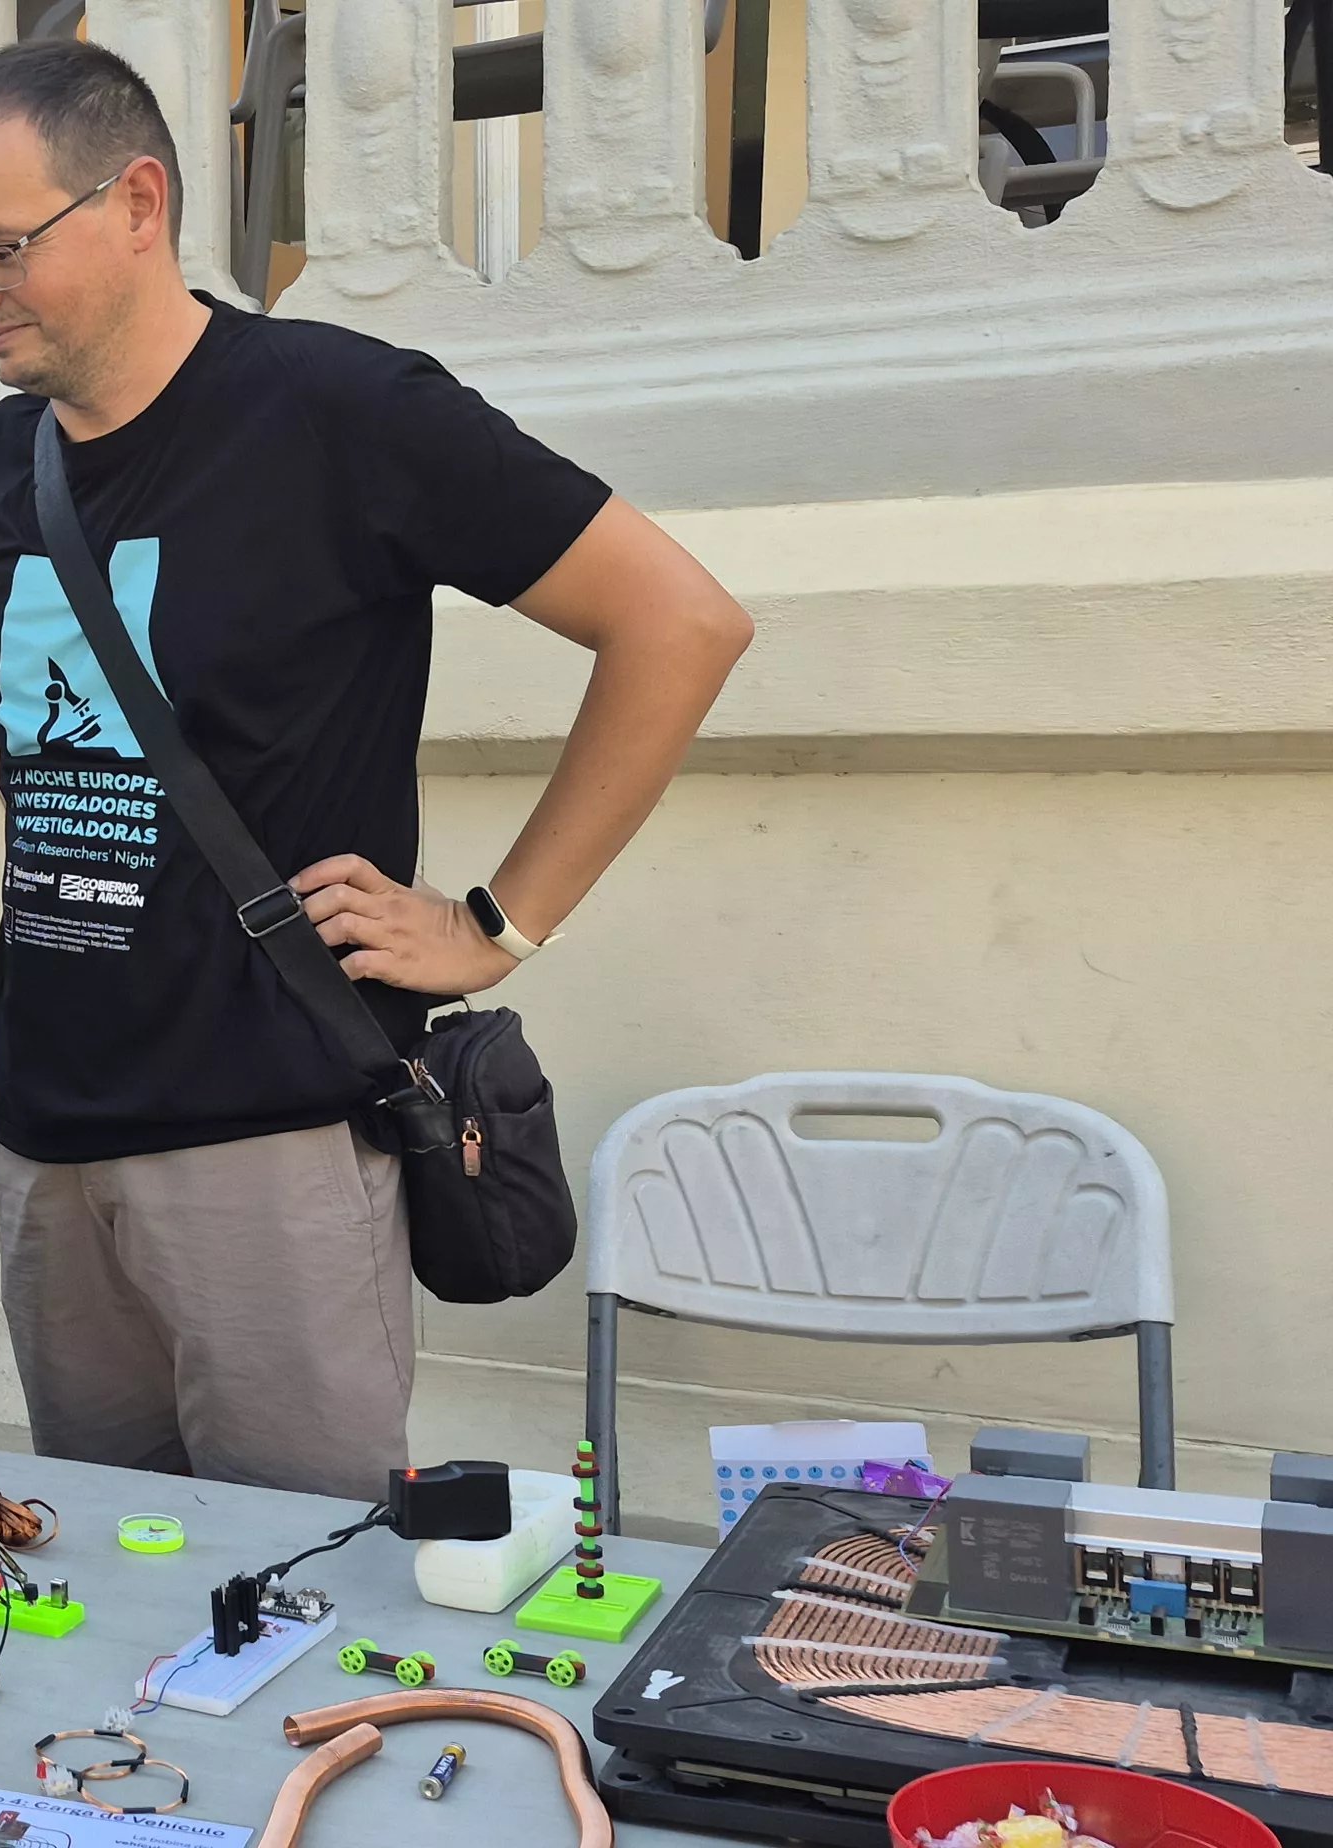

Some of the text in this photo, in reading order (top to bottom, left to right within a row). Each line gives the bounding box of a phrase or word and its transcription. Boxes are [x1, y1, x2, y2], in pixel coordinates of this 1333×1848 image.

[10, 769, 22, 785] LA
[24, 769, 76, 788] NOCHE
[14, 791, 157, 820] INVESTIGADORES
[15, 815, 159, 845] INVESTIGADORAS
[115, 850, 157, 870] Night
[78, 890, 94, 901] DE
[80, 877, 139, 894] GOBIERNO
[8, 1798, 30, 1807] 4:
[34, 1802, 94, 1818] Carga
[99, 1811, 126, 1822] de
[132, 1815, 226, 1837] Vehículo
